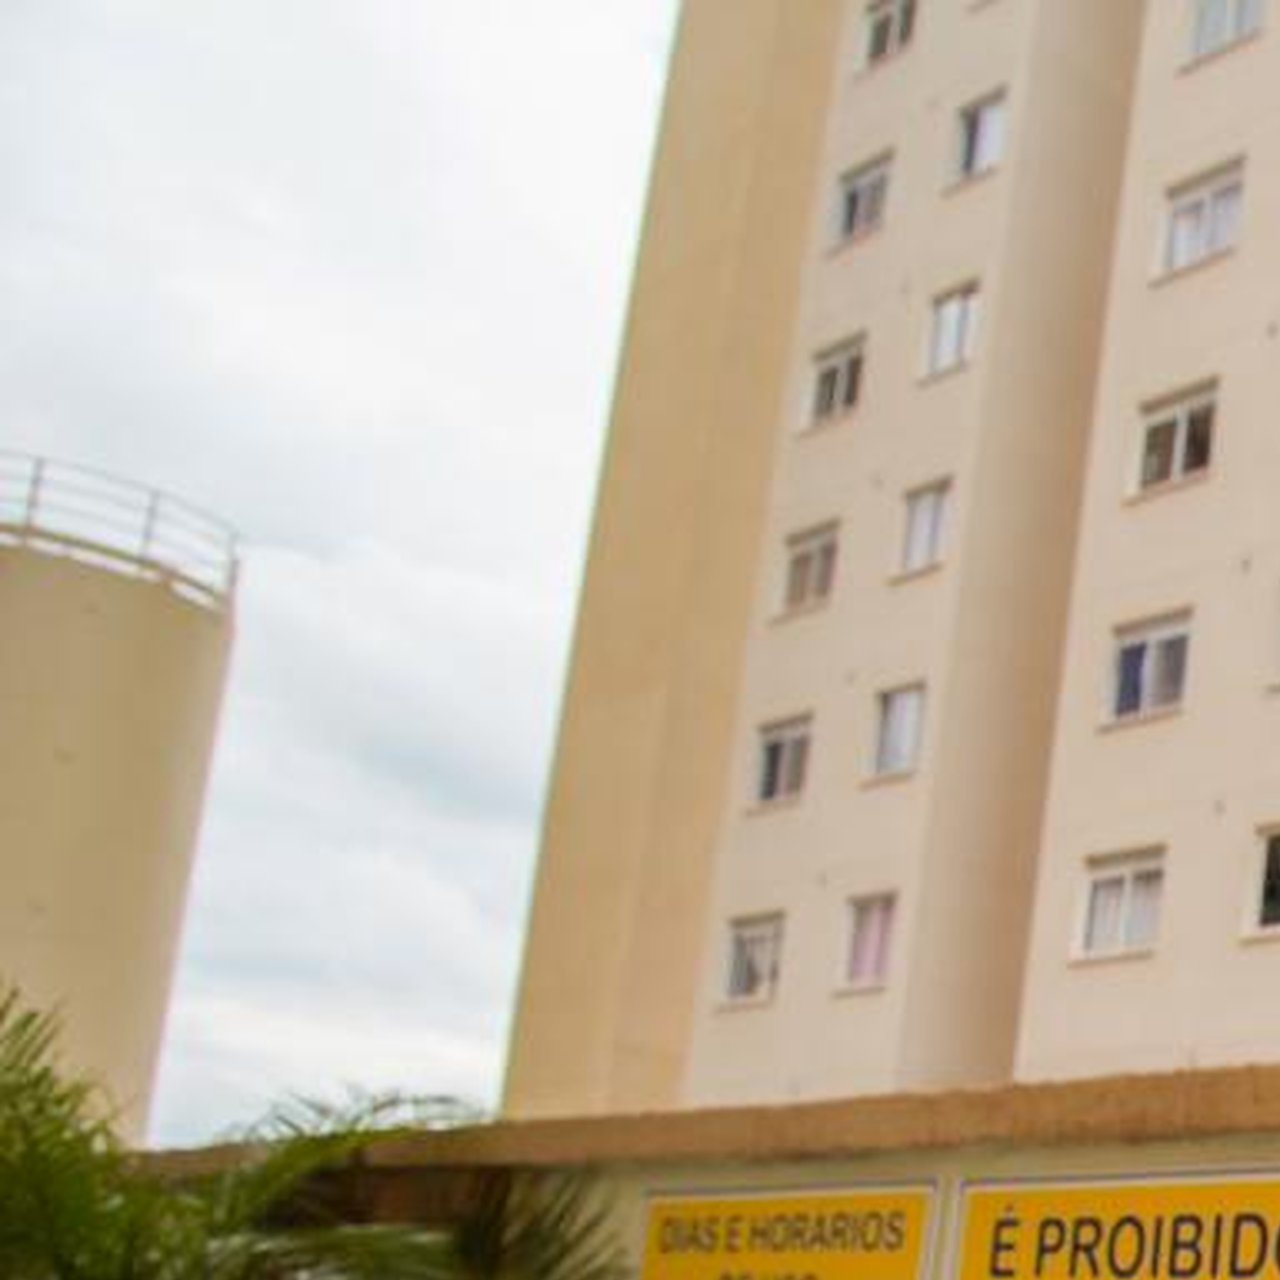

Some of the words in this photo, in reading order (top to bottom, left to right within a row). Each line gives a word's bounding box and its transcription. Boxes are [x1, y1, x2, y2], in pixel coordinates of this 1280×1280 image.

[657, 1214, 720, 1253] DIAS
[722, 1214, 745, 1253] E
[987, 1204, 1022, 1279] É
